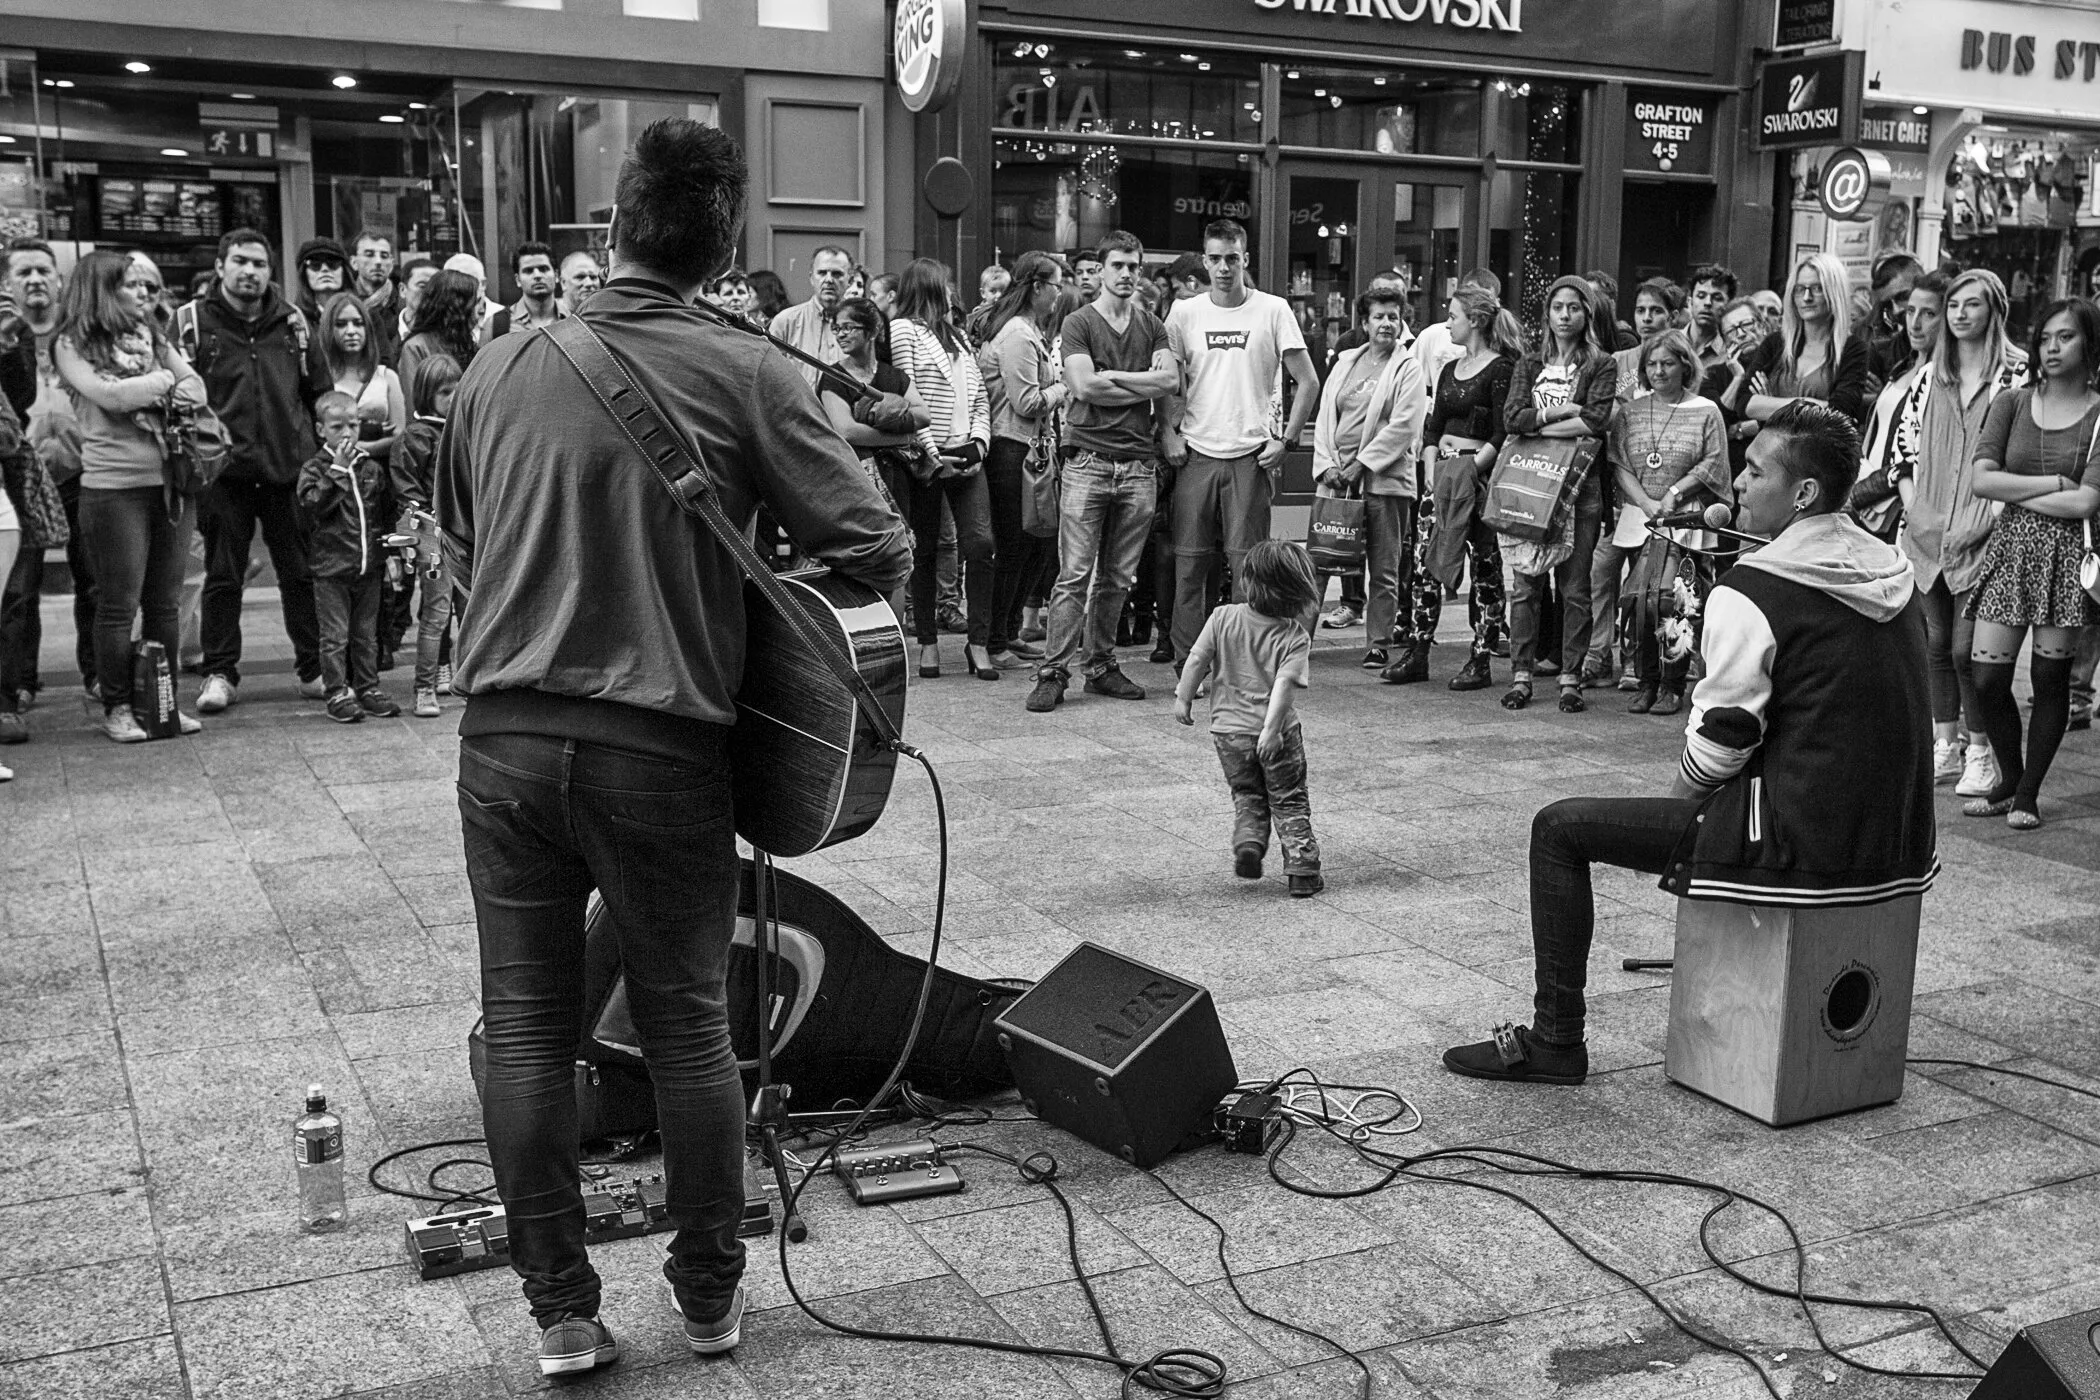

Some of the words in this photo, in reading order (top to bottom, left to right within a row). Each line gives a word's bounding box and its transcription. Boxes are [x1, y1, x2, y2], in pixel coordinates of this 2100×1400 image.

[897, 7, 933, 74] KING
[1960, 28, 2036, 76] BUS
[1635, 103, 1703, 124] GRAFTON
[1763, 107, 1839, 134] SWAROVSKI
[1642, 122, 1693, 141] STREET
[1897, 120, 1929, 145] CAFE
